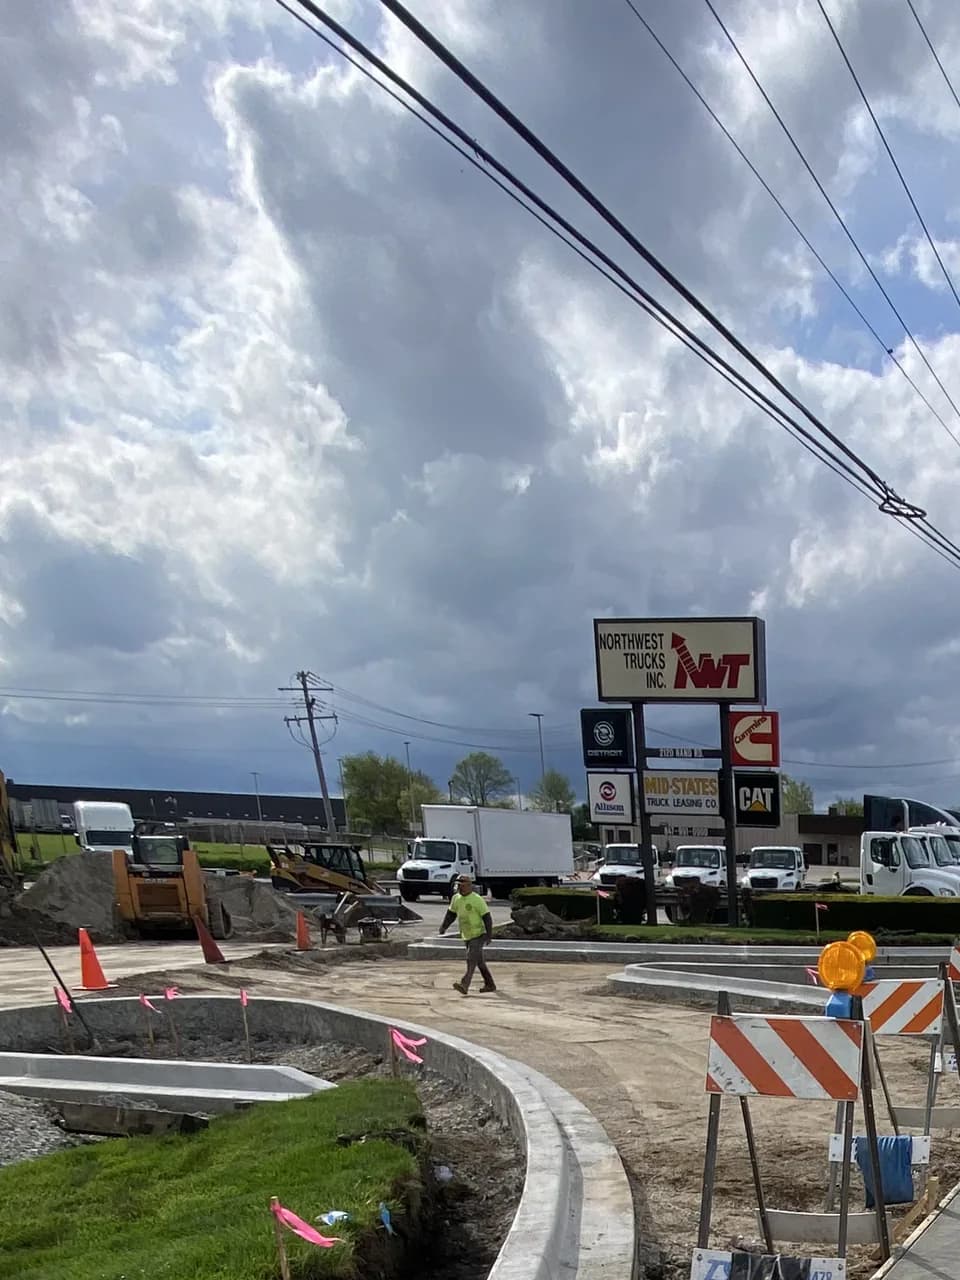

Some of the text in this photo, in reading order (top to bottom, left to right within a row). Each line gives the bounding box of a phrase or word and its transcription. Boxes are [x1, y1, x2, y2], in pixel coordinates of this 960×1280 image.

[600, 633, 664, 650] NORTHWEST
[624, 653, 666, 669] TRUCKS
[646, 672, 667, 688] INC.
[734, 716, 768, 744] Cummins
[645, 777, 718, 796] MID-STATES
[594, 802, 625, 812] Allison
[647, 798, 718, 809] TRUCK LEASING CO.
[739, 786, 774, 813] CAT
